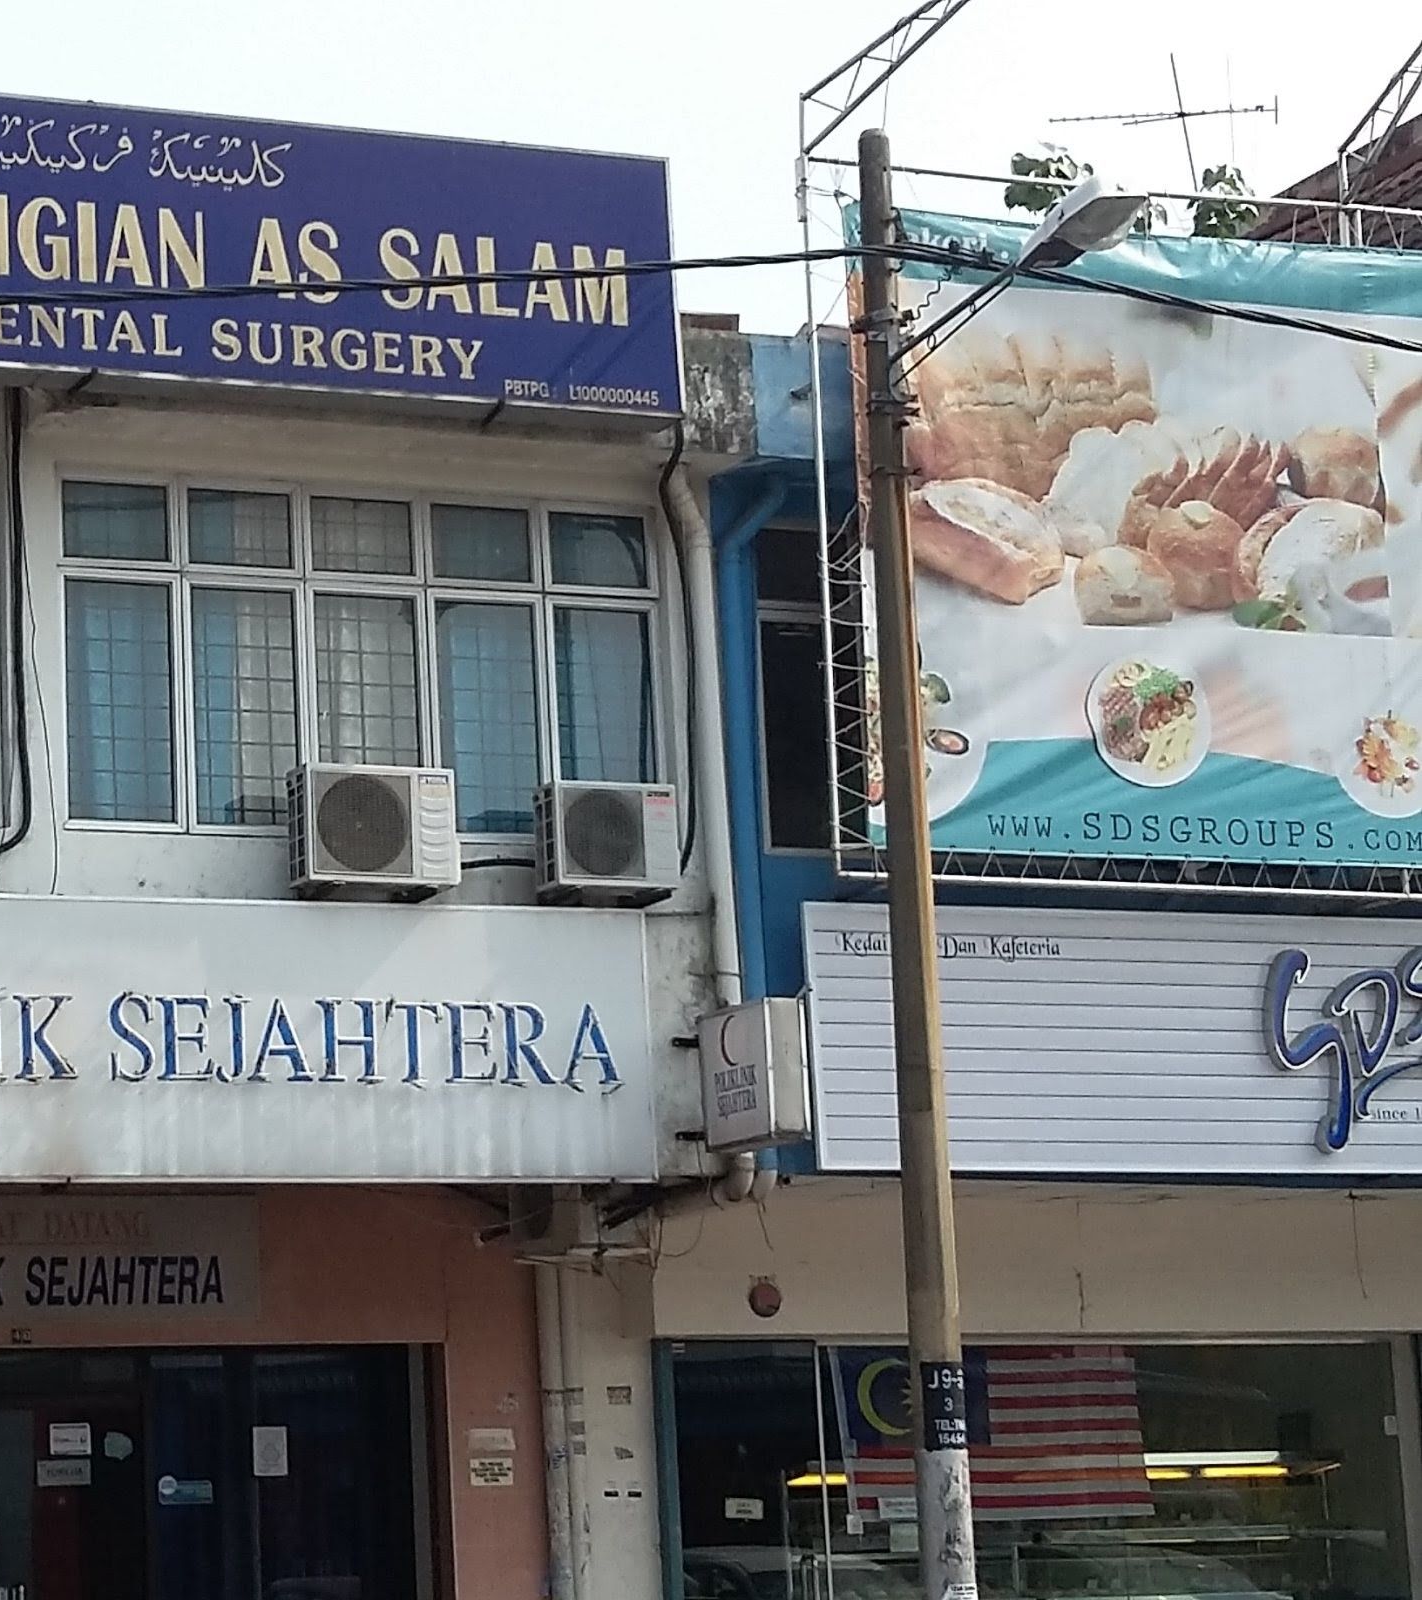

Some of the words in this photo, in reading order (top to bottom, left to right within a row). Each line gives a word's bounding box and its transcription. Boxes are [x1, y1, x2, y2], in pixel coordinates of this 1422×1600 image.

[249, 216, 342, 304] AS
[379, 226, 629, 327] SALAM
[212, 317, 483, 381] SURGERY
[837, 932, 888, 957] Kedai
[939, 934, 977, 958] Dan
[984, 936, 1061, 963] Kafeteria
[109, 991, 624, 1090] SEJAHTERA
[25, 1255, 224, 1307] SEJAHTERA
[943, 1396, 954, 1413] 3
